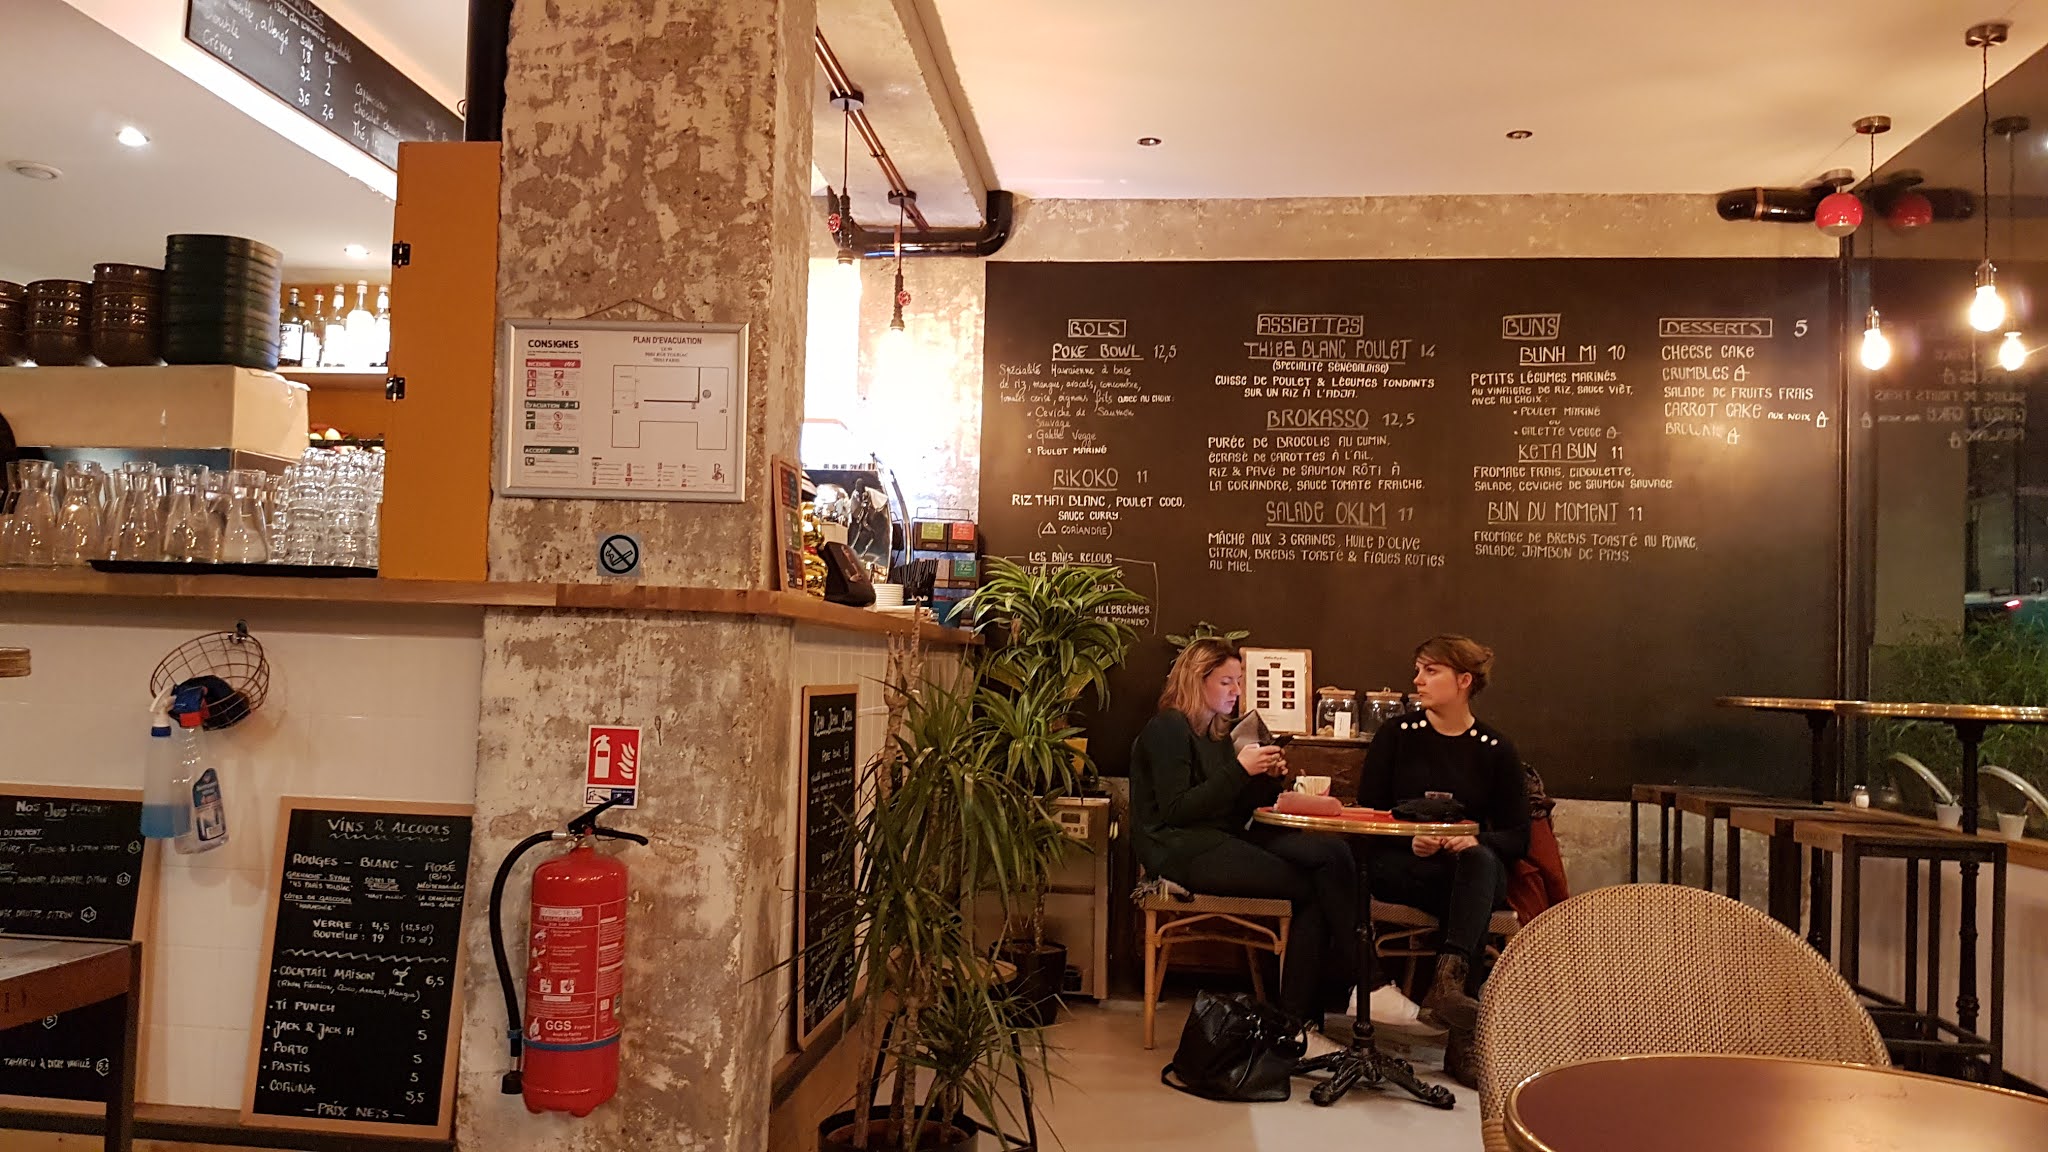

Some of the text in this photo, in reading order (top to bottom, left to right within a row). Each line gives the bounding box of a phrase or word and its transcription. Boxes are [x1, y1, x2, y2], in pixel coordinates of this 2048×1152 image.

[325, 83, 330, 96] 2
[1070, 322, 1120, 336] BOLS
[1260, 317, 1360, 334] ASSIETTES
[1505, 318, 1557, 336] BUNS
[1664, 320, 1808, 337] DESSERTS 5
[528, 340, 579, 349] CONSIGNES
[633, 336, 651, 344] PLAN
[1053, 344, 1176, 362] POKE BOWL 12,5
[1302, 340, 1346, 359] BLANC
[1356, 340, 1412, 359] POULET
[1421, 345, 1436, 357] 14
[1520, 346, 1565, 362] BUNH
[1608, 345, 1625, 360] 10
[1662, 345, 1754, 360] CHEESE CAKE
[1471, 372, 1514, 385] PETITS
[1663, 367, 1729, 381] CRUMBLES
[1215, 376, 1247, 385] CUISSE
[1273, 377, 1311, 387] POULET
[1317, 378, 1325, 386] &
[1384, 379, 1434, 388] FONDANTS
[1245, 388, 1298, 397] SUR UN RIZ
[1664, 387, 1704, 398] SALADE
[1732, 387, 1772, 399] FRUITS
[1779, 387, 1813, 400] FRAIS
[1076, 409, 1085, 417] de
[1521, 407, 1556, 416] POULET
[1665, 402, 1718, 417] CARROT
[1726, 403, 1762, 419] CAKE
[1268, 409, 1415, 428] BROKASSO 12,5
[1277, 436, 1329, 448] BROCOLIS
[1339, 437, 1352, 446] AU
[1038, 446, 1068, 455] POULET
[1271, 452, 1325, 462] CAROTTES
[1519, 443, 1623, 459] KETA BUN 11
[1054, 468, 1148, 487] RIKOKO 11
[1209, 466, 1227, 477] RIZ
[1232, 467, 1241, 476] &
[1301, 465, 1345, 476] SAUMON
[1474, 466, 1525, 478] FROMAGE
[1210, 480, 1371, 491] LA SAUCE TOMATE
[1519, 481, 1562, 491] CEVICHE
[1586, 479, 1624, 488] SAUMON
[1631, 479, 1672, 488] SAUVAGE
[1012, 494, 1153, 507] RIZ POULET
[1059, 511, 1084, 520] SAUCE
[1267, 501, 1413, 526] SALADE OKLM 11
[1489, 501, 1642, 521] BUN DU MOMENT 11
[1252, 533, 1271, 545] AUX
[1278, 534, 1286, 545] 3
[1346, 536, 1373, 548] HUILE
[1475, 531, 1523, 543] FROMAGE
[1547, 533, 1586, 544] BREBIS
[1255, 549, 1295, 561] BREBIS
[1348, 551, 1357, 562] &
[1365, 551, 1400, 564] FIGUES
[1522, 545, 1571, 559] JAMBON
[328, 817, 450, 835] VINS ALCOOLS
[293, 854, 399, 869] ROUGES BLANC
[313, 920, 389, 932] VERRE 4,5
[313, 930, 384, 942] BOUTEILLE 19
[280, 965, 444, 987] COCKTAIL MAISON 6,5
[295, 1001, 430, 1019] PUNCH 5
[273, 1020, 427, 1040] JACK JACK H 5
[546, 1020, 571, 1030] GGS
[274, 1042, 422, 1063] PORTO 5
[272, 1061, 419, 1082] PASTIS 5
[406, 1091, 425, 1104] 5,5
